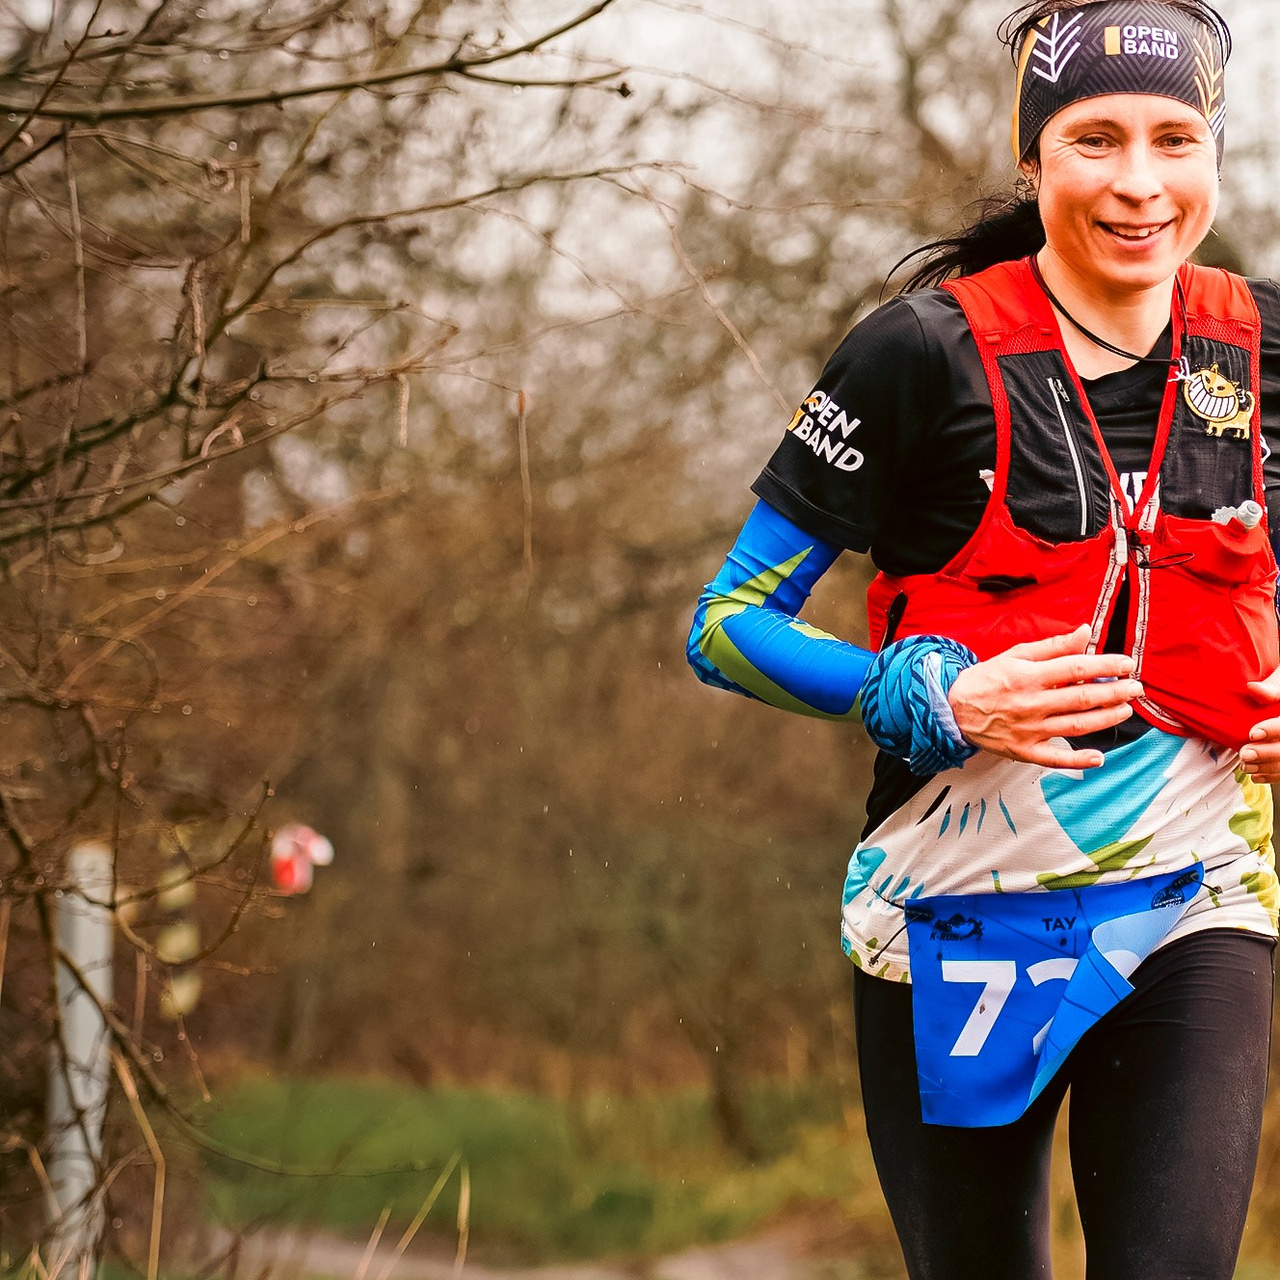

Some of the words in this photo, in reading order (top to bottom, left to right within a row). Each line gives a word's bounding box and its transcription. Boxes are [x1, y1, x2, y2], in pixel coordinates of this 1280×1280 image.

[1123, 25, 1178, 45] OPEN
[1124, 39, 1179, 60] BAND
[808, 390, 862, 439] OEN
[792, 414, 864, 472] BAND
[1041, 916, 1077, 932] TAY
